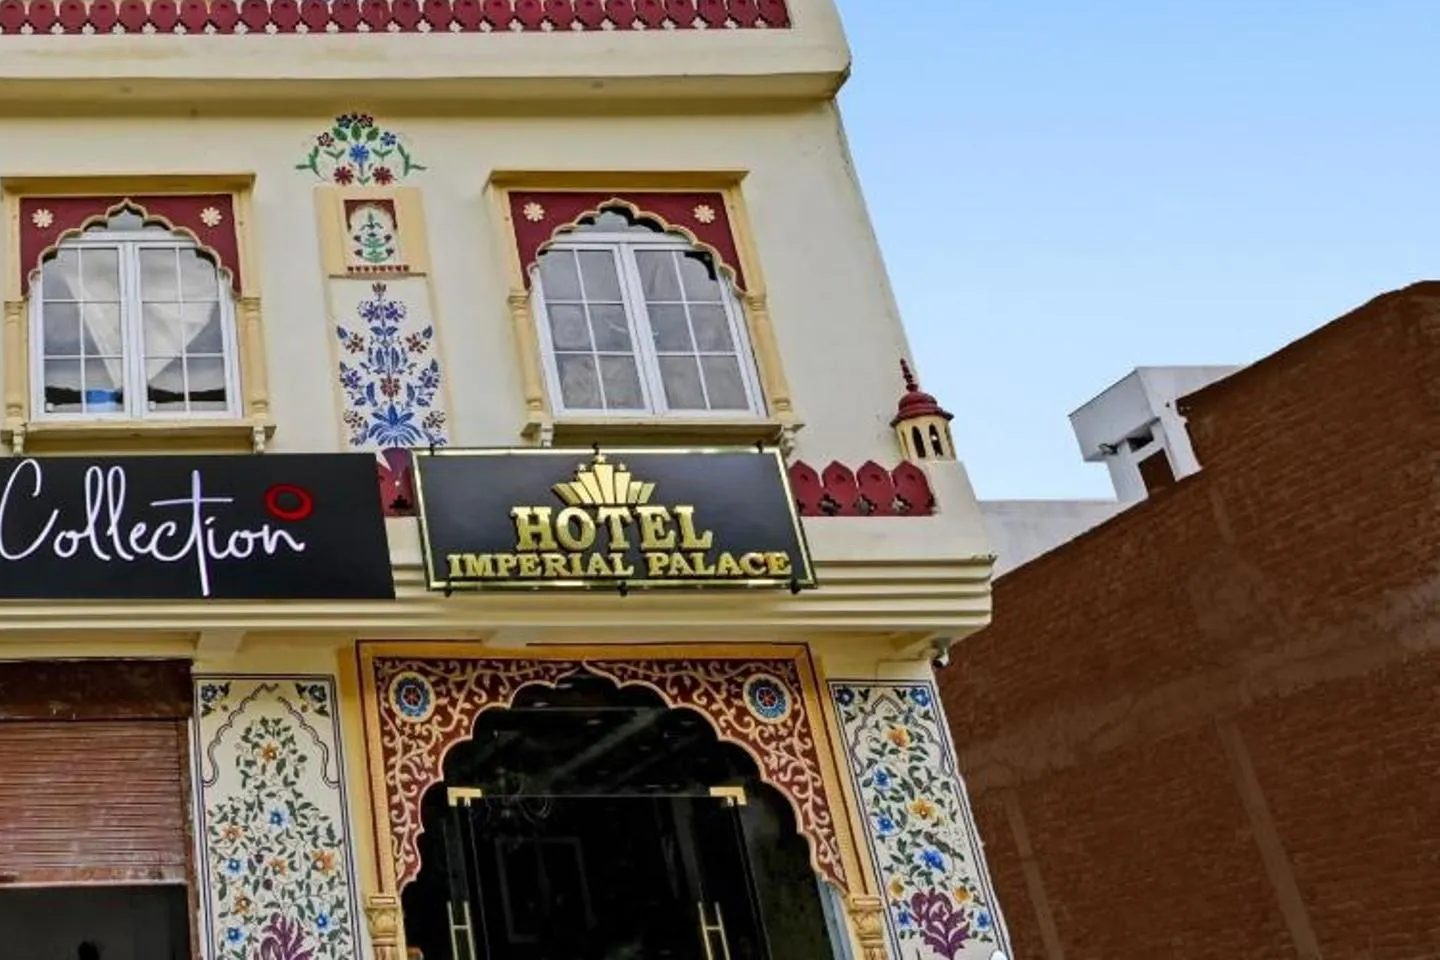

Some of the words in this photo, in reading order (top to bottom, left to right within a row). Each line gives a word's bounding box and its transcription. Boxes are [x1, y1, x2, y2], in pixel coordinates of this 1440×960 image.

[512, 504, 713, 551] HOTEL
[447, 553, 634, 578] IMPERIAL
[646, 551, 792, 576] PALACE
